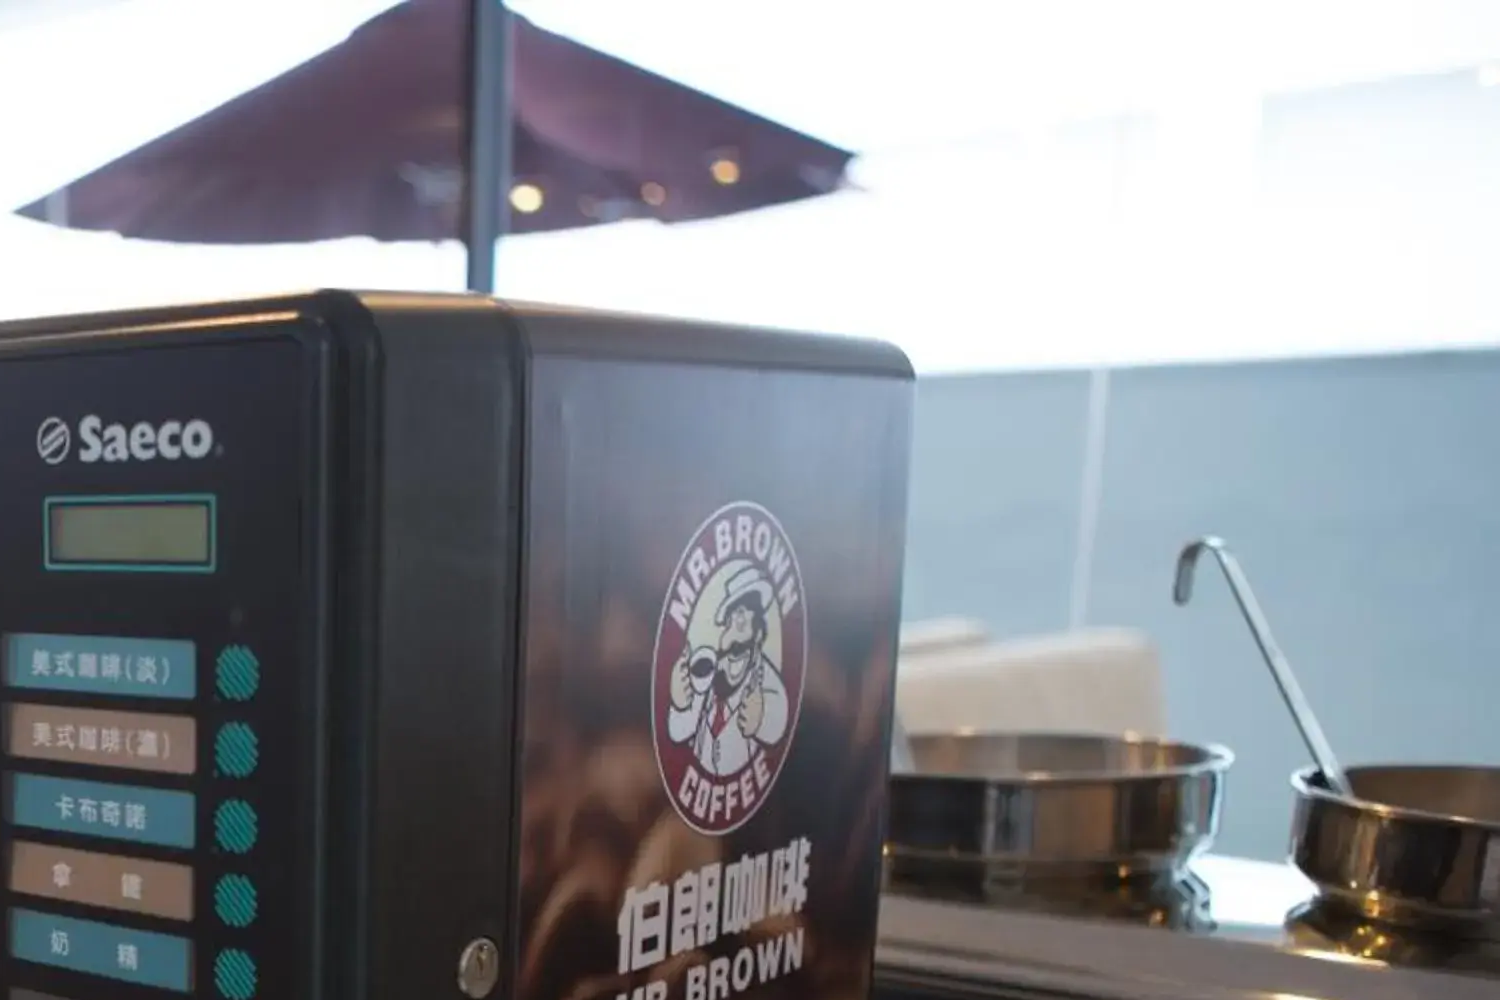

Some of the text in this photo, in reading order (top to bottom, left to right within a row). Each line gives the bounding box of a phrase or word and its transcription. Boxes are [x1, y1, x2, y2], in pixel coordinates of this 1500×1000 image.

[78, 414, 213, 462] Saeco
[669, 514, 799, 631] MR. BROWN
[54, 794, 148, 831] 卡布奇諾
[678, 748, 772, 823] COFFEE
[616, 836, 811, 976] 伯朗咖啡
